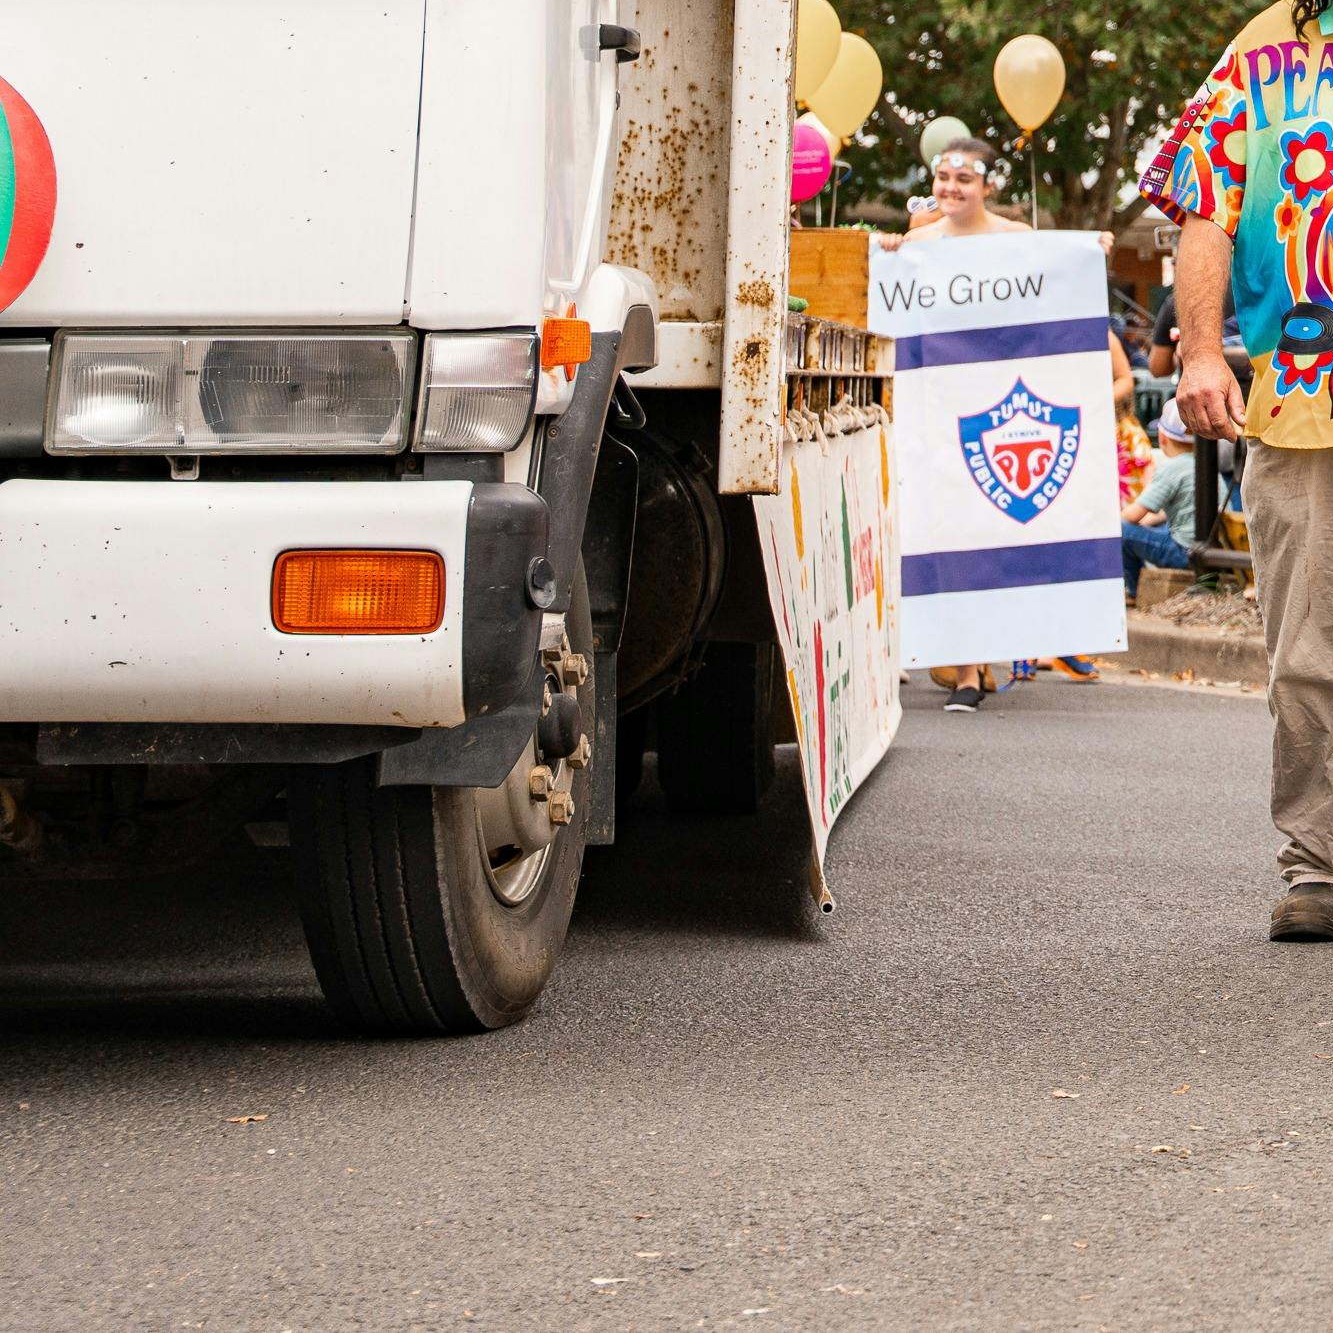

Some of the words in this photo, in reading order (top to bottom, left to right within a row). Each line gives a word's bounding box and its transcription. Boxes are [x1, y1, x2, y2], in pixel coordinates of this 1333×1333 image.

[878, 279, 936, 313] We
[948, 273, 1044, 307] Grow
[989, 392, 1053, 426] TUMUT
[964, 441, 1013, 509] PUBLIC
[1032, 424, 1079, 510] SCHOOL
